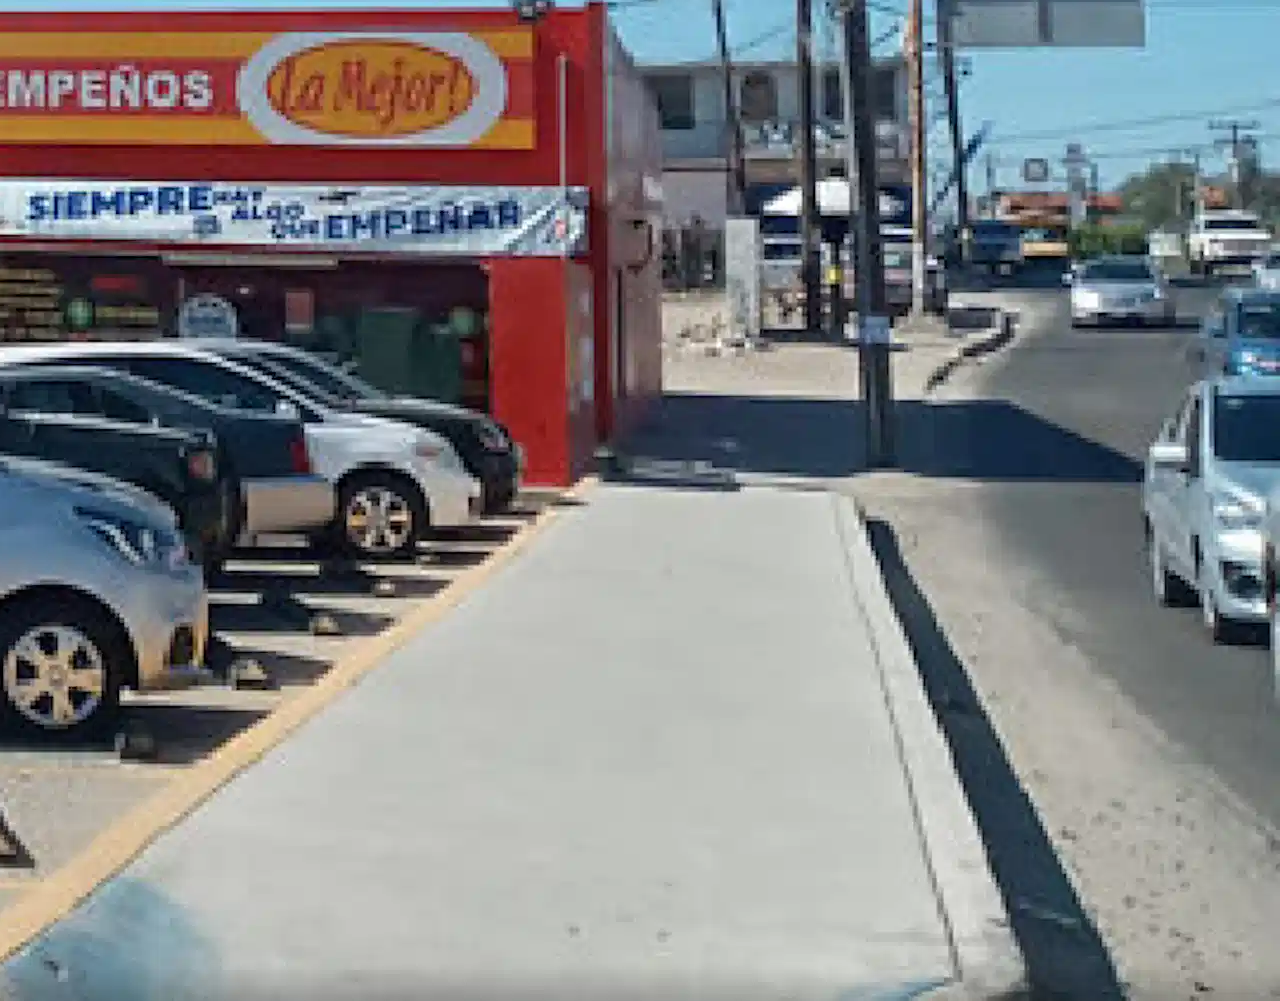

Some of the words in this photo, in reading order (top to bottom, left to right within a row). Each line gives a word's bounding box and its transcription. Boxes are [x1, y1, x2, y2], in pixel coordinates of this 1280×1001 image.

[279, 59, 326, 113] La
[333, 58, 460, 126] Mejor!
[28, 185, 212, 220] SIEMPRE
[232, 200, 306, 222] ALGO
[271, 218, 322, 240] QUE
[327, 199, 519, 239] EMPEÑAR
